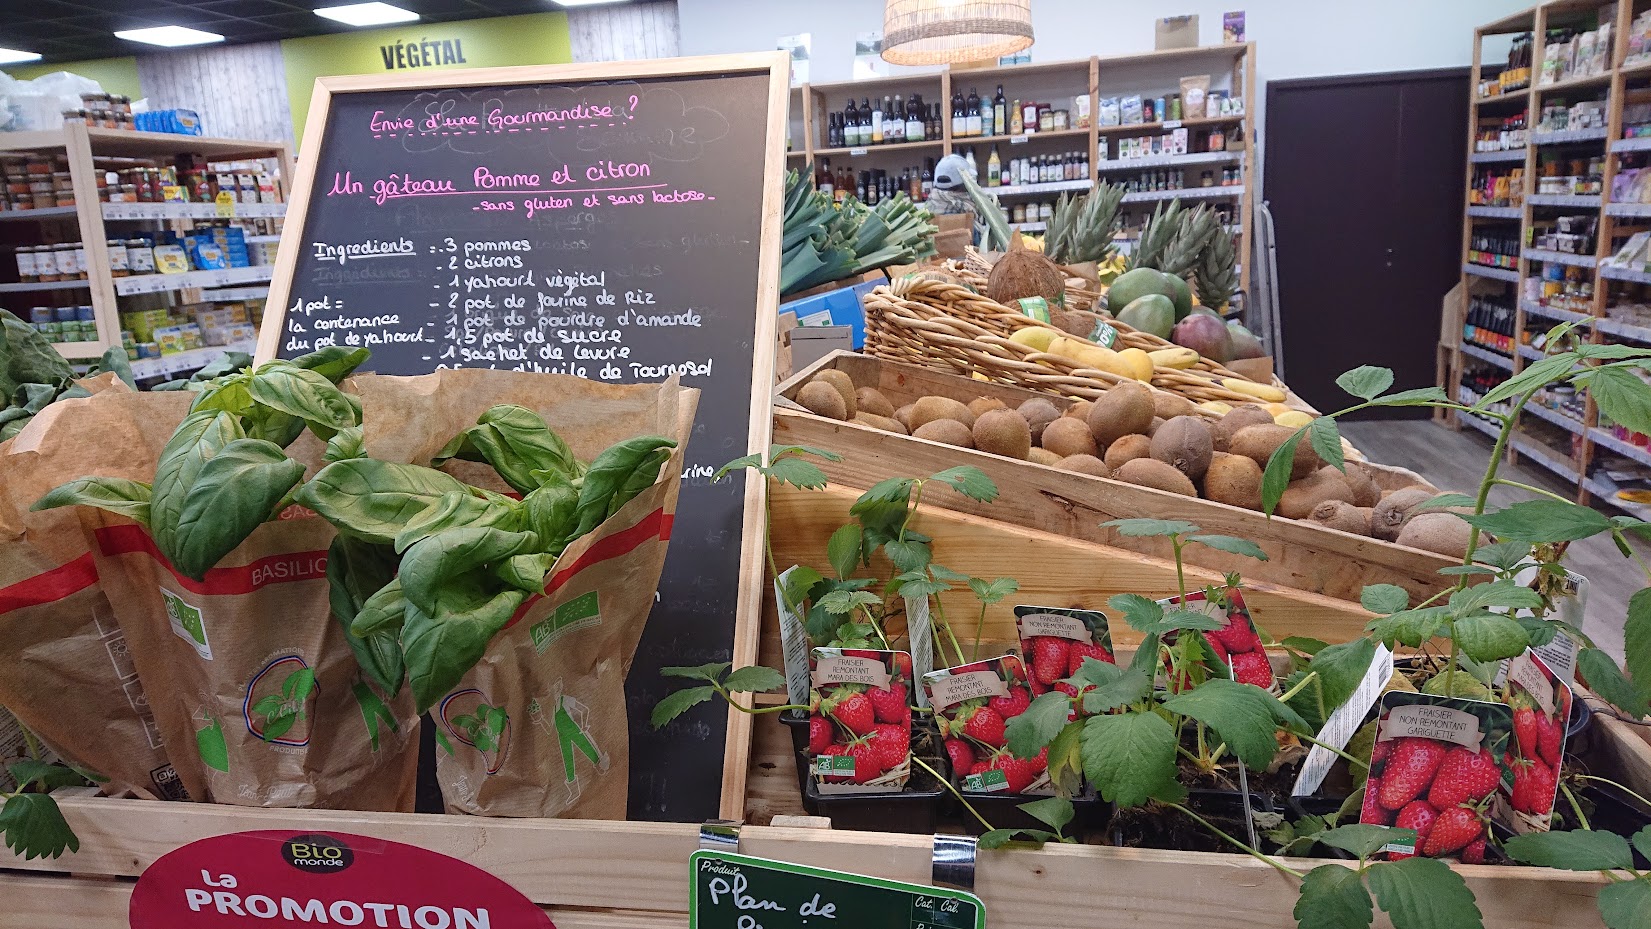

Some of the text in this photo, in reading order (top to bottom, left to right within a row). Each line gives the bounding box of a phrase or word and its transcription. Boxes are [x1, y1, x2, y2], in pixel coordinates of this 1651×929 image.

[380, 37, 467, 70] VÉGÉTAL
[370, 110, 415, 133] Envie
[426, 111, 480, 131] d'une
[487, 105, 613, 134] Gourmandise
[327, 161, 651, 207] Un gâteau Pomme et citron
[525, 195, 573, 219] gluten
[583, 193, 601, 208] et
[611, 193, 645, 206] sans
[313, 237, 414, 265] Ingredients
[463, 239, 532, 258] pommes
[463, 255, 524, 270] citrons
[463, 272, 536, 294] yahourt
[305, 295, 332, 316] pot
[463, 294, 496, 310] pot
[504, 293, 526, 308] de
[537, 291, 588, 316] farine
[595, 289, 616, 306] de
[624, 288, 657, 306] Riz
[288, 314, 401, 334] la contenance
[463, 312, 495, 330] pot
[504, 311, 526, 326] de
[617, 308, 702, 328] d'amande
[286, 327, 424, 352] du pot de yahourt
[482, 329, 516, 349] pot
[523, 329, 546, 344] de
[557, 328, 623, 344] sucre
[460, 343, 528, 362] sachet
[540, 345, 565, 361] de
[600, 362, 622, 380] de
[252, 557, 328, 586] BASILIC
[832, 666, 870, 675] REMONTANT
[838, 659, 864, 667] FRAISIER
[860, 675, 875, 683] BOIS
[947, 680, 984, 695] REMONTANT
[950, 673, 977, 685] FRAISIER
[963, 691, 976, 699] DES
[977, 686, 993, 695] BOIS
[1418, 707, 1453, 719] FRAISIER
[1399, 715, 1468, 731] NON REMONTANT
[1407, 726, 1456, 741] GARIGUETTE
[291, 842, 342, 859] Bio
[293, 857, 344, 867] monde
[700, 860, 740, 876] Produit
[201, 868, 238, 889] La
[708, 873, 837, 919] Plan de
[915, 895, 960, 913] Cat. Cal.
[184, 888, 492, 929] PROMOTION
